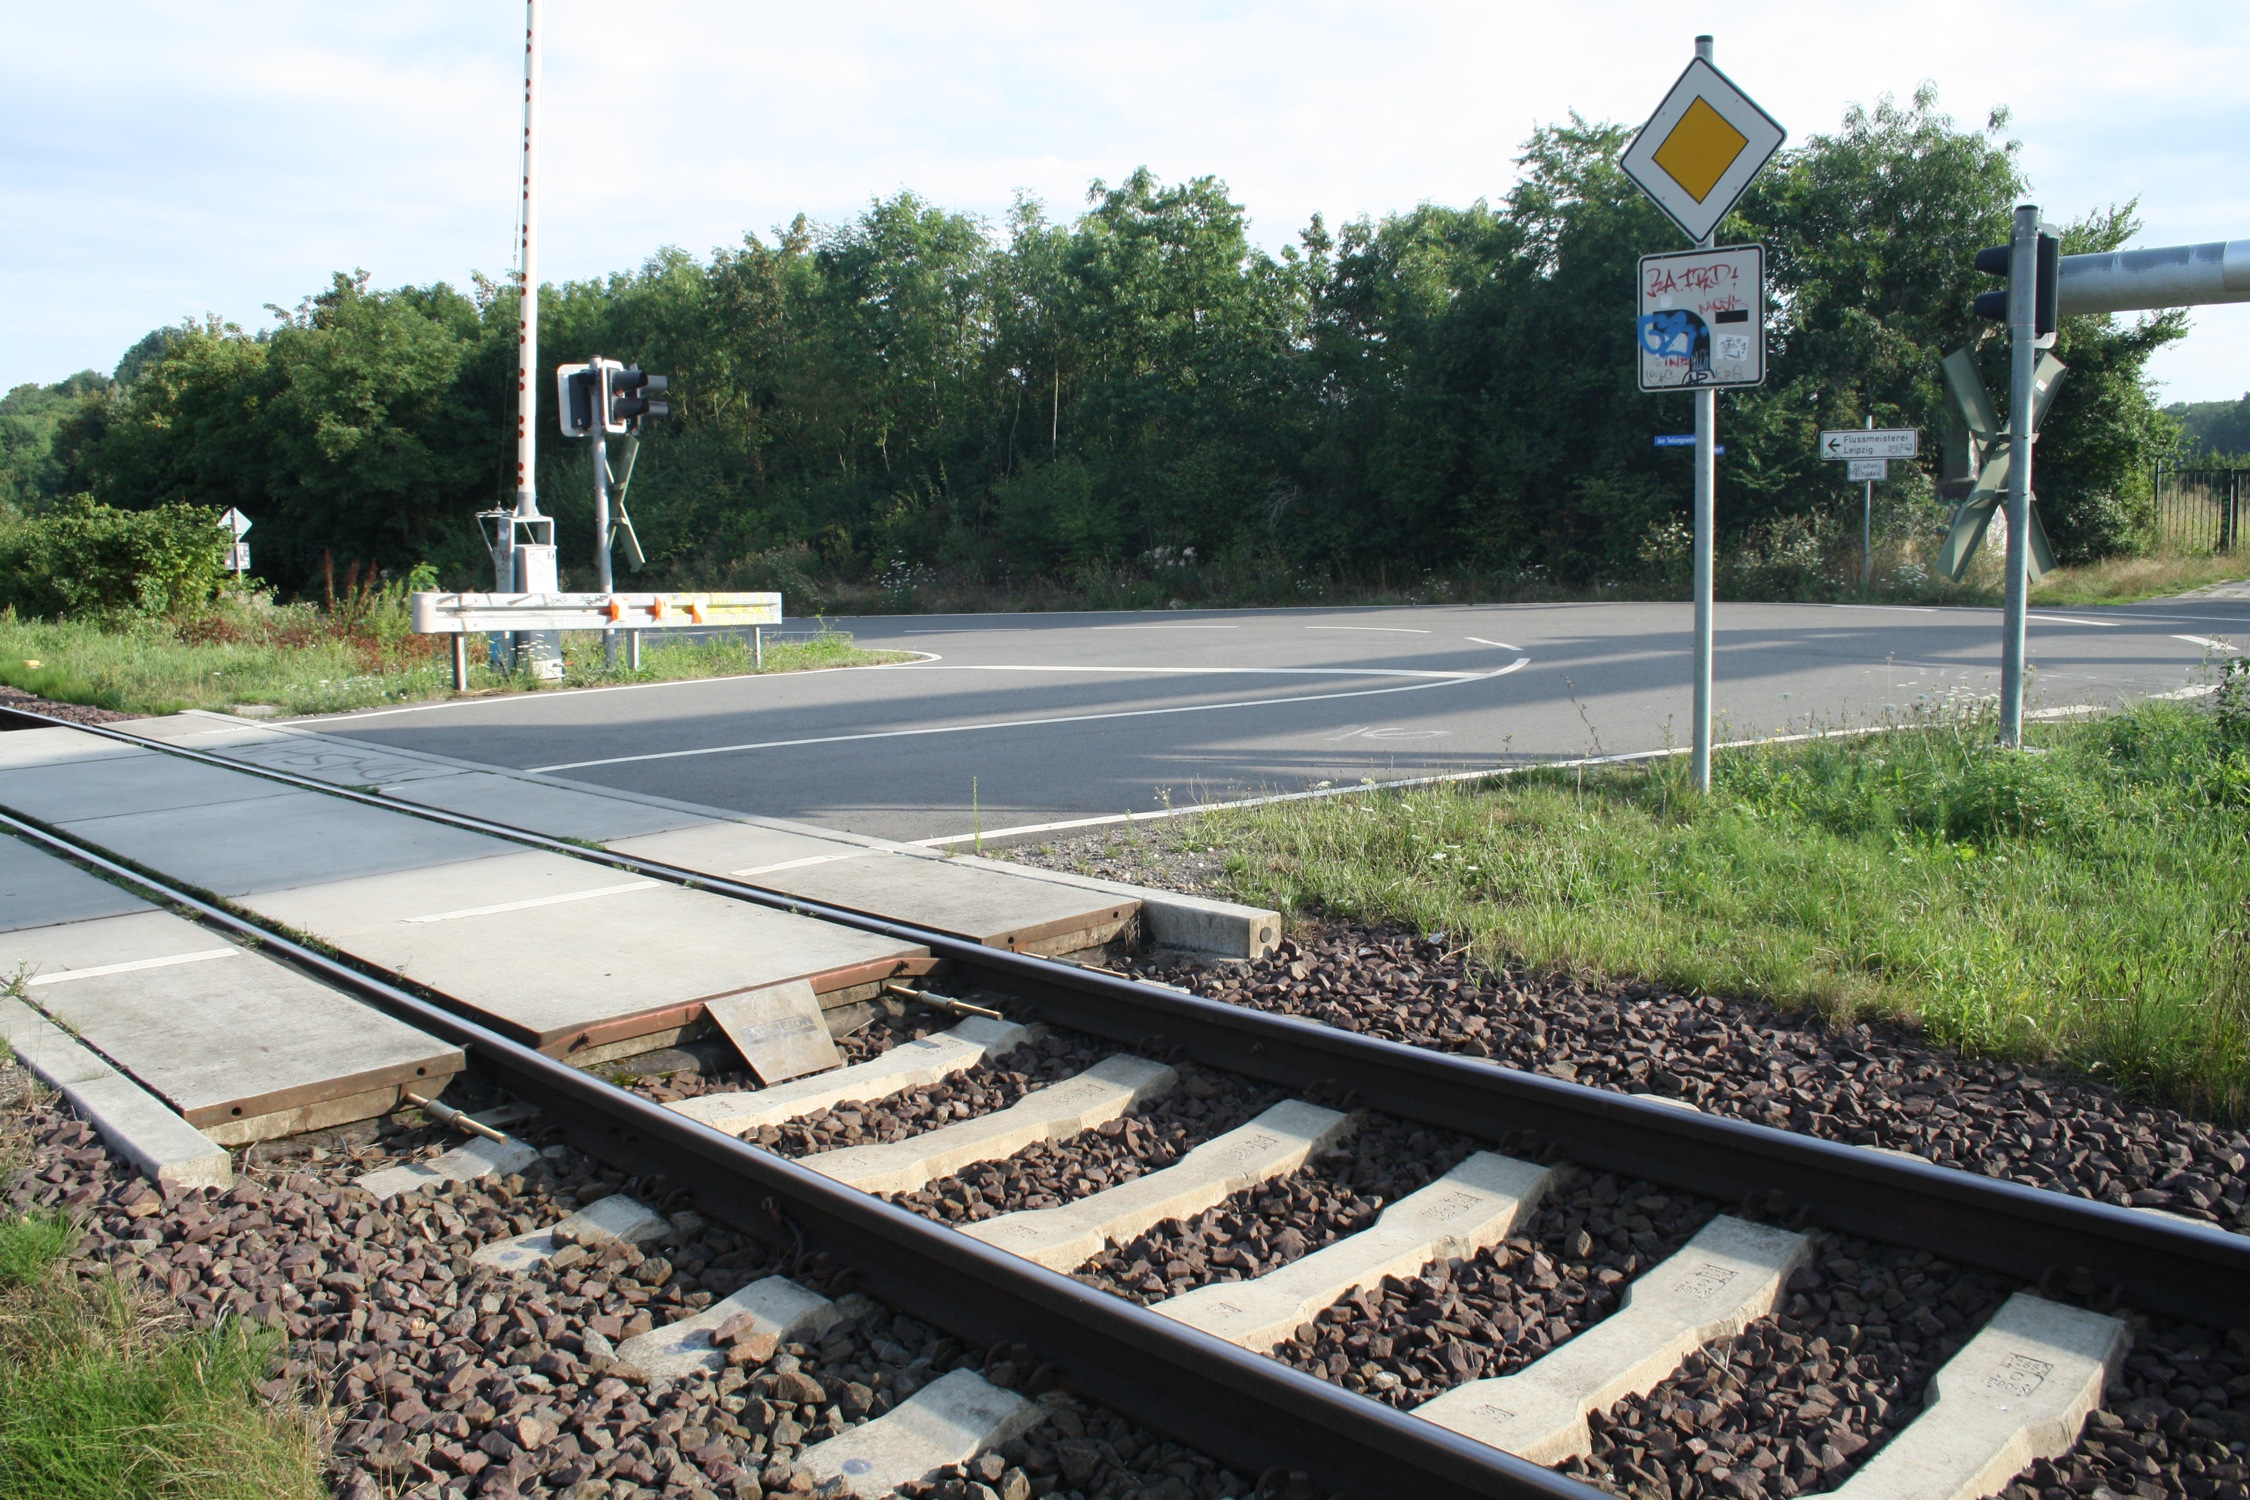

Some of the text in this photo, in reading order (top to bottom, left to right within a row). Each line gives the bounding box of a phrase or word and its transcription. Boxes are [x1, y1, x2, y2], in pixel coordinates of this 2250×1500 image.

[577, 418, 582, 426] 5
[1843, 434, 1909, 444] Flussmeisterei
[1843, 446, 1873, 455] Leipzig
